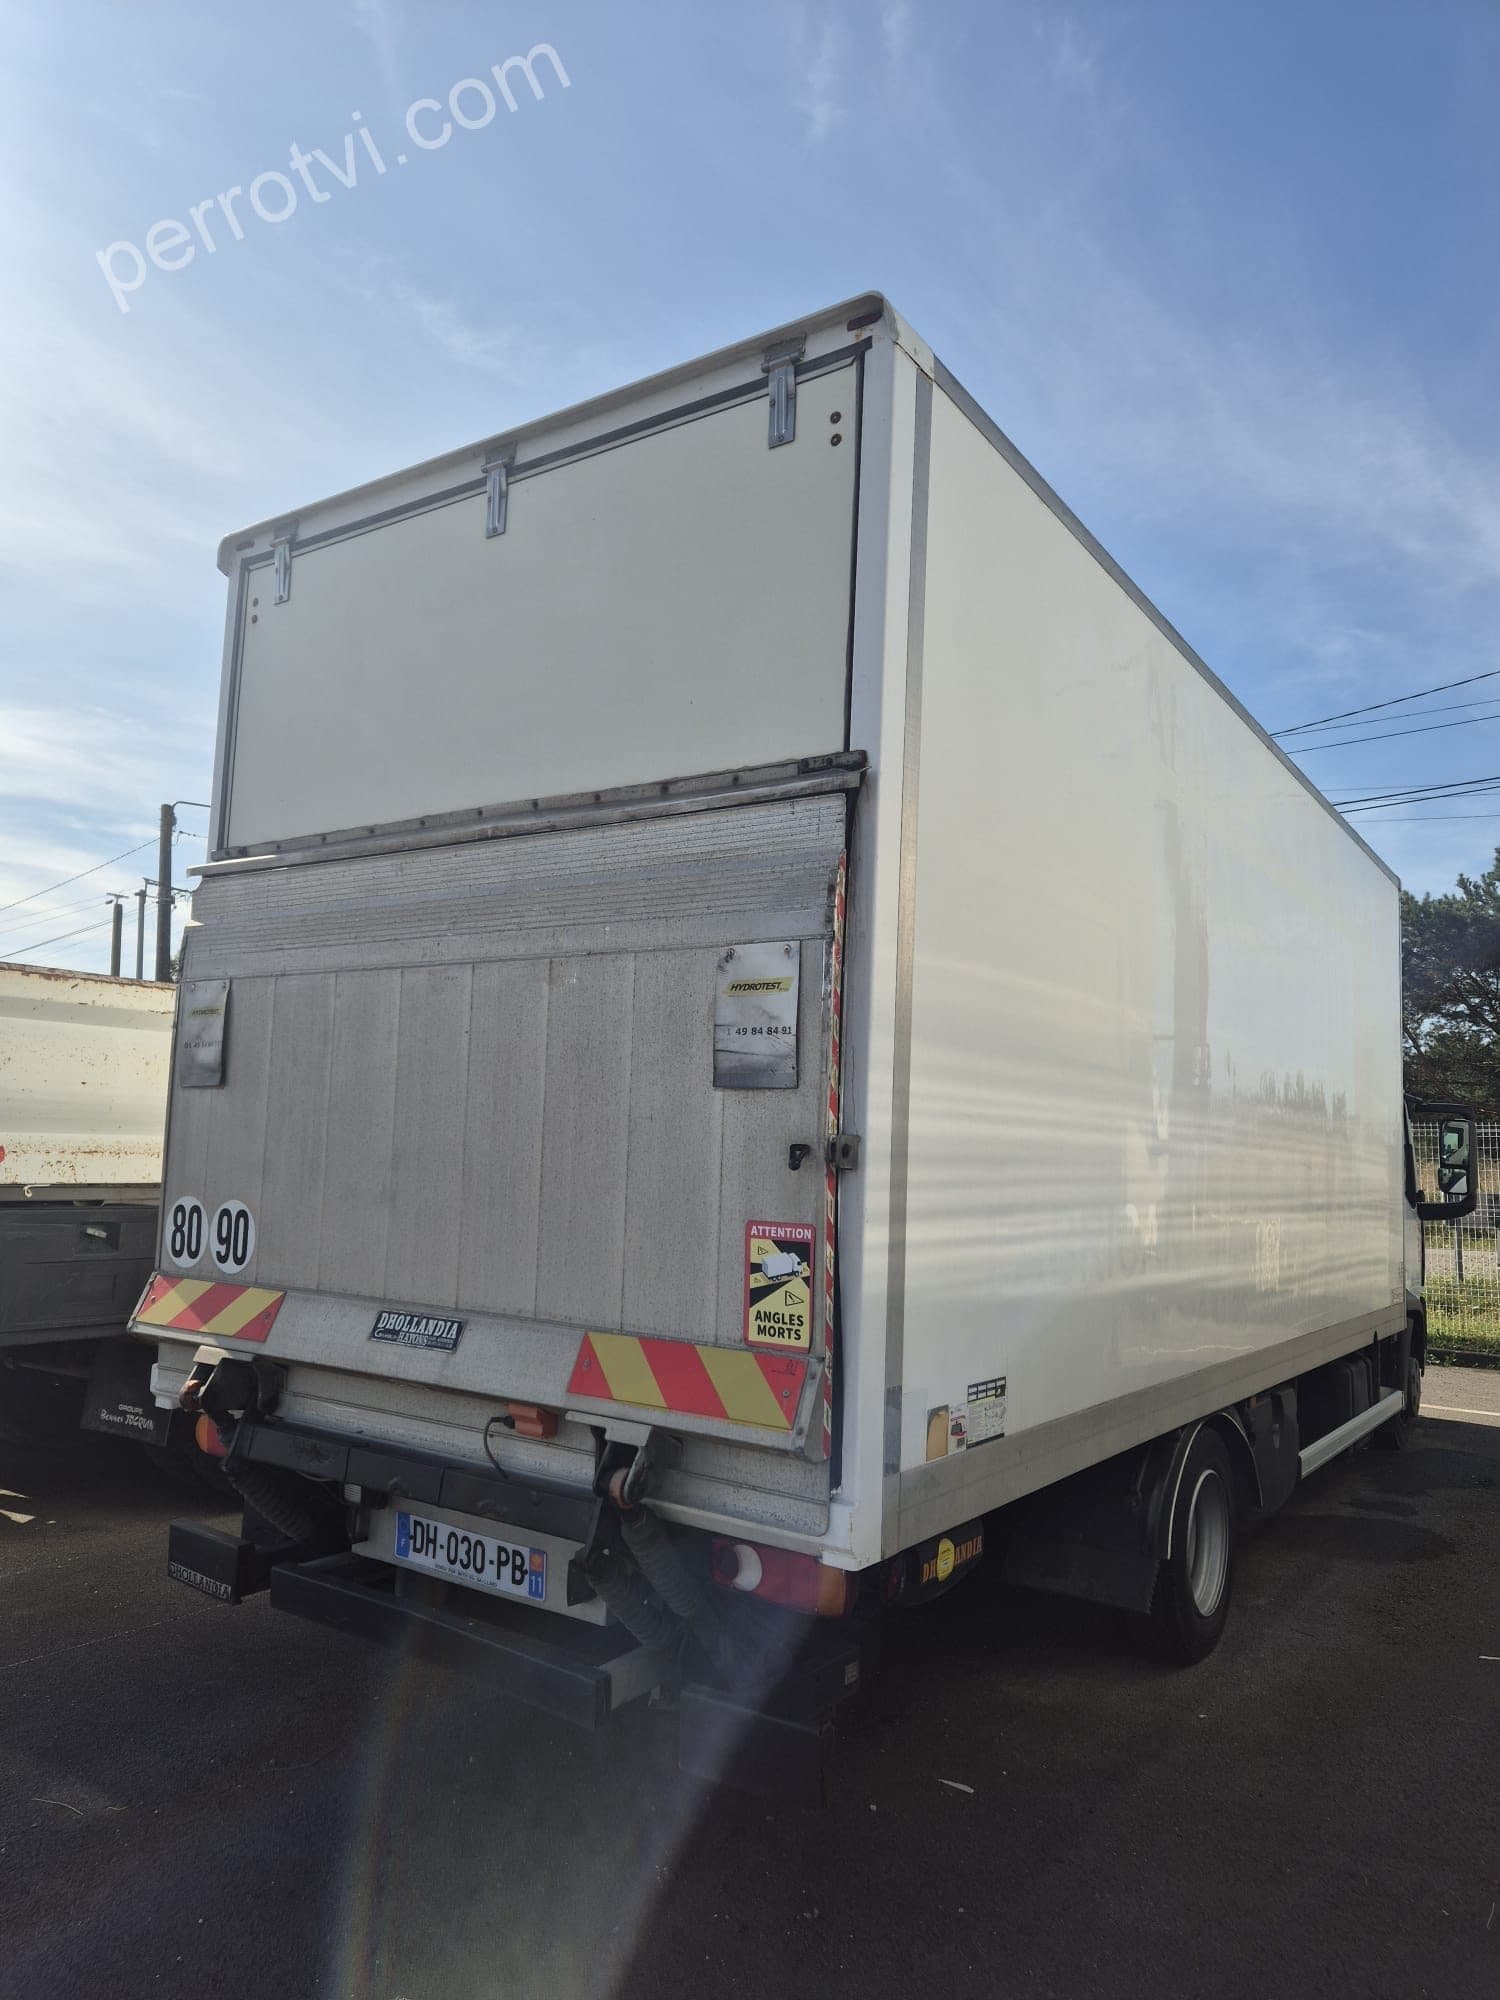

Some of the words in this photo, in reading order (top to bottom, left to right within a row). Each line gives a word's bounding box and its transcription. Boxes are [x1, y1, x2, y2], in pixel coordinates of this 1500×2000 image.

[730, 981, 782, 992] HYDROTEST
[735, 1027, 748, 1036] 49
[751, 1026, 764, 1036] 84
[766, 1026, 779, 1036] 84
[781, 1026, 793, 1035] 91
[171, 1204, 202, 1259] 80
[216, 1208, 249, 1266] 90
[750, 1225, 812, 1239] ATTENTION
[377, 1312, 459, 1339] DHOLLANDIA
[754, 1310, 804, 1327] ANGLES
[757, 1326, 802, 1341] MORTS
[410, 1519, 527, 1586] DH-030-PB
[530, 1575, 543, 1594] 11
